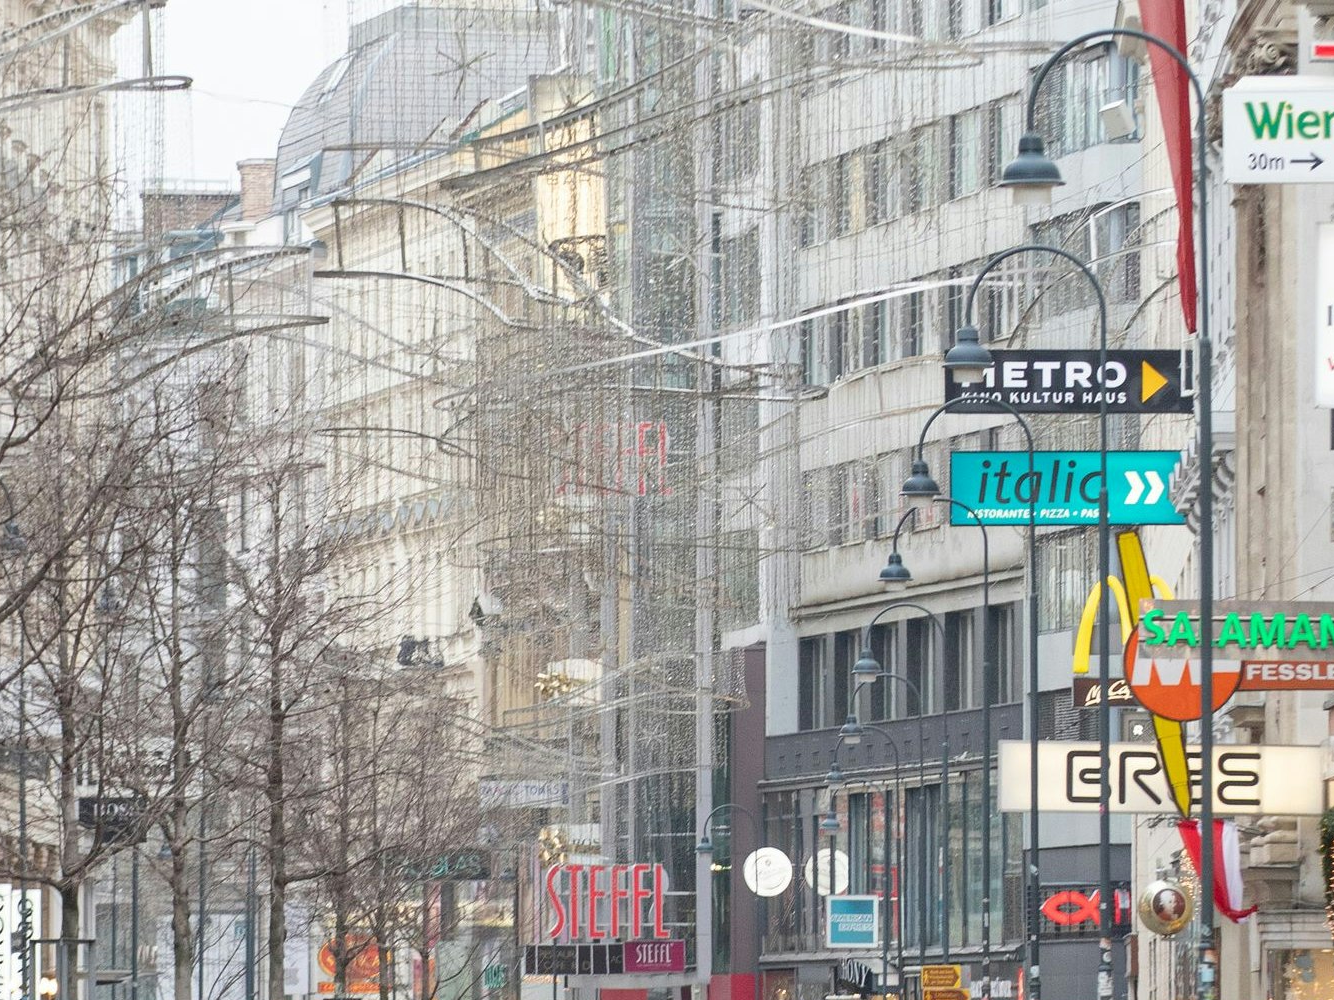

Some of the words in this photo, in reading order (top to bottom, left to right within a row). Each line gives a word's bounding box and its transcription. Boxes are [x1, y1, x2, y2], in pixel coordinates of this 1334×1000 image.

[1248, 153, 1284, 170] 30m
[1010, 391, 1078, 404] KULTUR
[1083, 391, 1127, 404] HAUS
[1039, 508, 1070, 519] PIZZA
[1080, 508, 1110, 519] PAS
[546, 863, 672, 939] STEFFL
[635, 943, 672, 964] STEFFL
